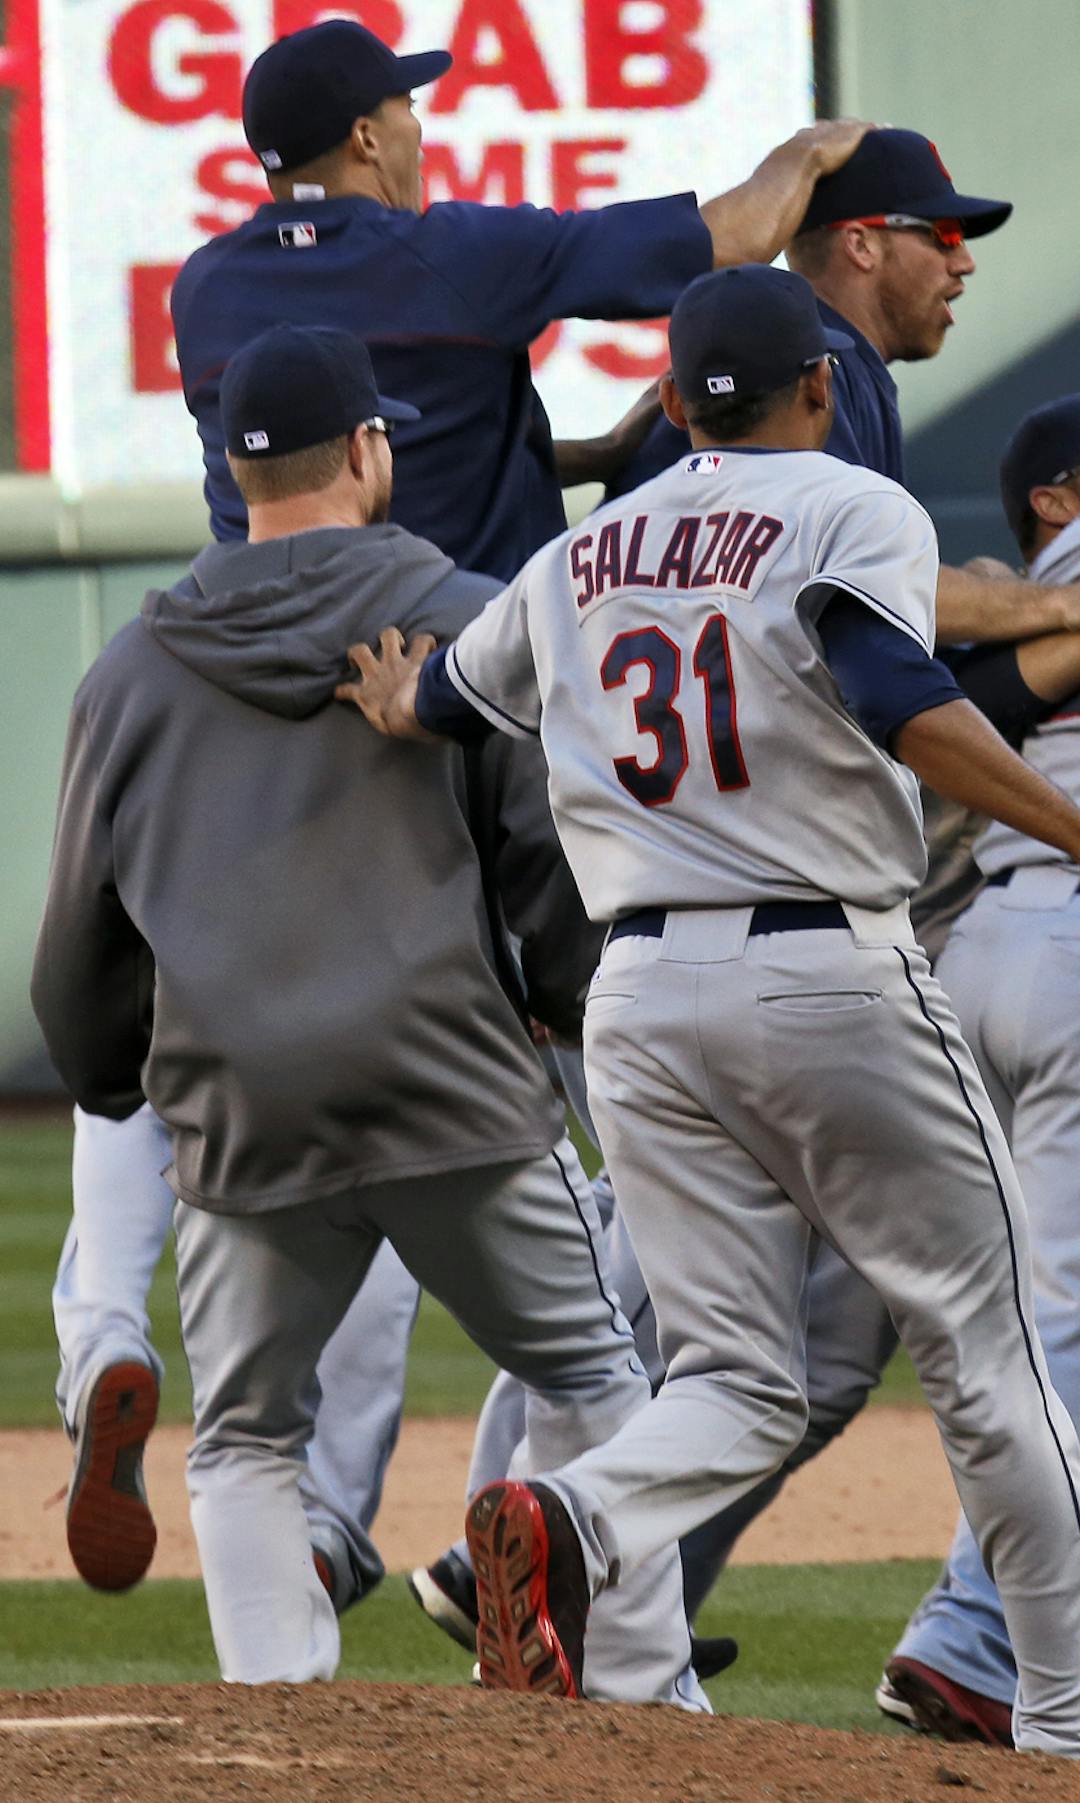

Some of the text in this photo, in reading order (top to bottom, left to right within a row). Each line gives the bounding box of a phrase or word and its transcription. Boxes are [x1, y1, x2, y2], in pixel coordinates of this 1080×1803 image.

[192, 137, 628, 237] SME
[570, 511, 784, 608] SALAZAR
[600, 613, 751, 808] 31
